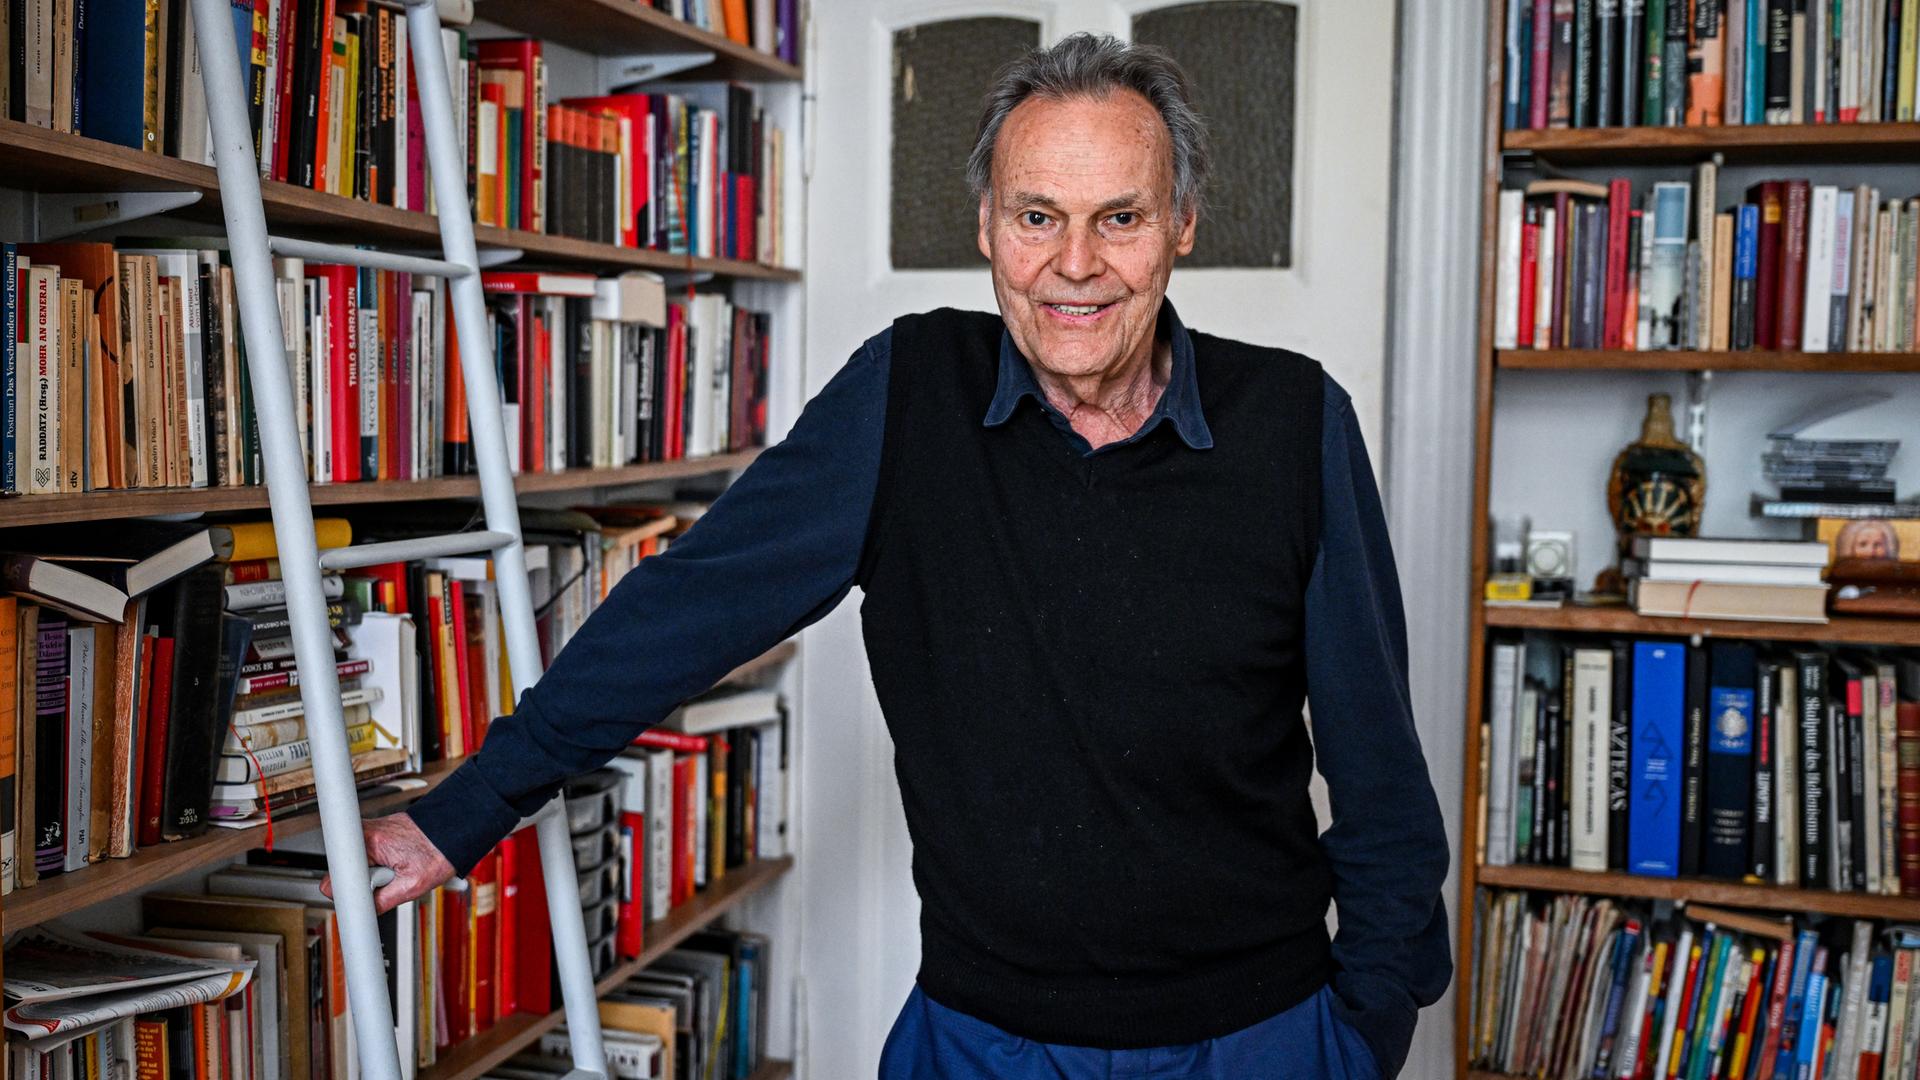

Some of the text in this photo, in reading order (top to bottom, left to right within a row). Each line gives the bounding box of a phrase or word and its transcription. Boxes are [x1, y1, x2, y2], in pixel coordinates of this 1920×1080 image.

[6, 251, 15, 438] Postman Das Verschwinden der Kindheit
[347, 287, 358, 386] THILO SARRAZIN
[38, 278, 49, 461] RADDATZ (Hrsg.) MOHR AN GENERAL
[6, 450, 15, 482] Fischer
[69, 471, 77, 489] dtv
[150, 417, 159, 481] Wilhelm Reich
[1801, 697, 1822, 747] Skulptur
[1610, 722, 1629, 811] AZTECAS
[1805, 748, 1822, 771] des
